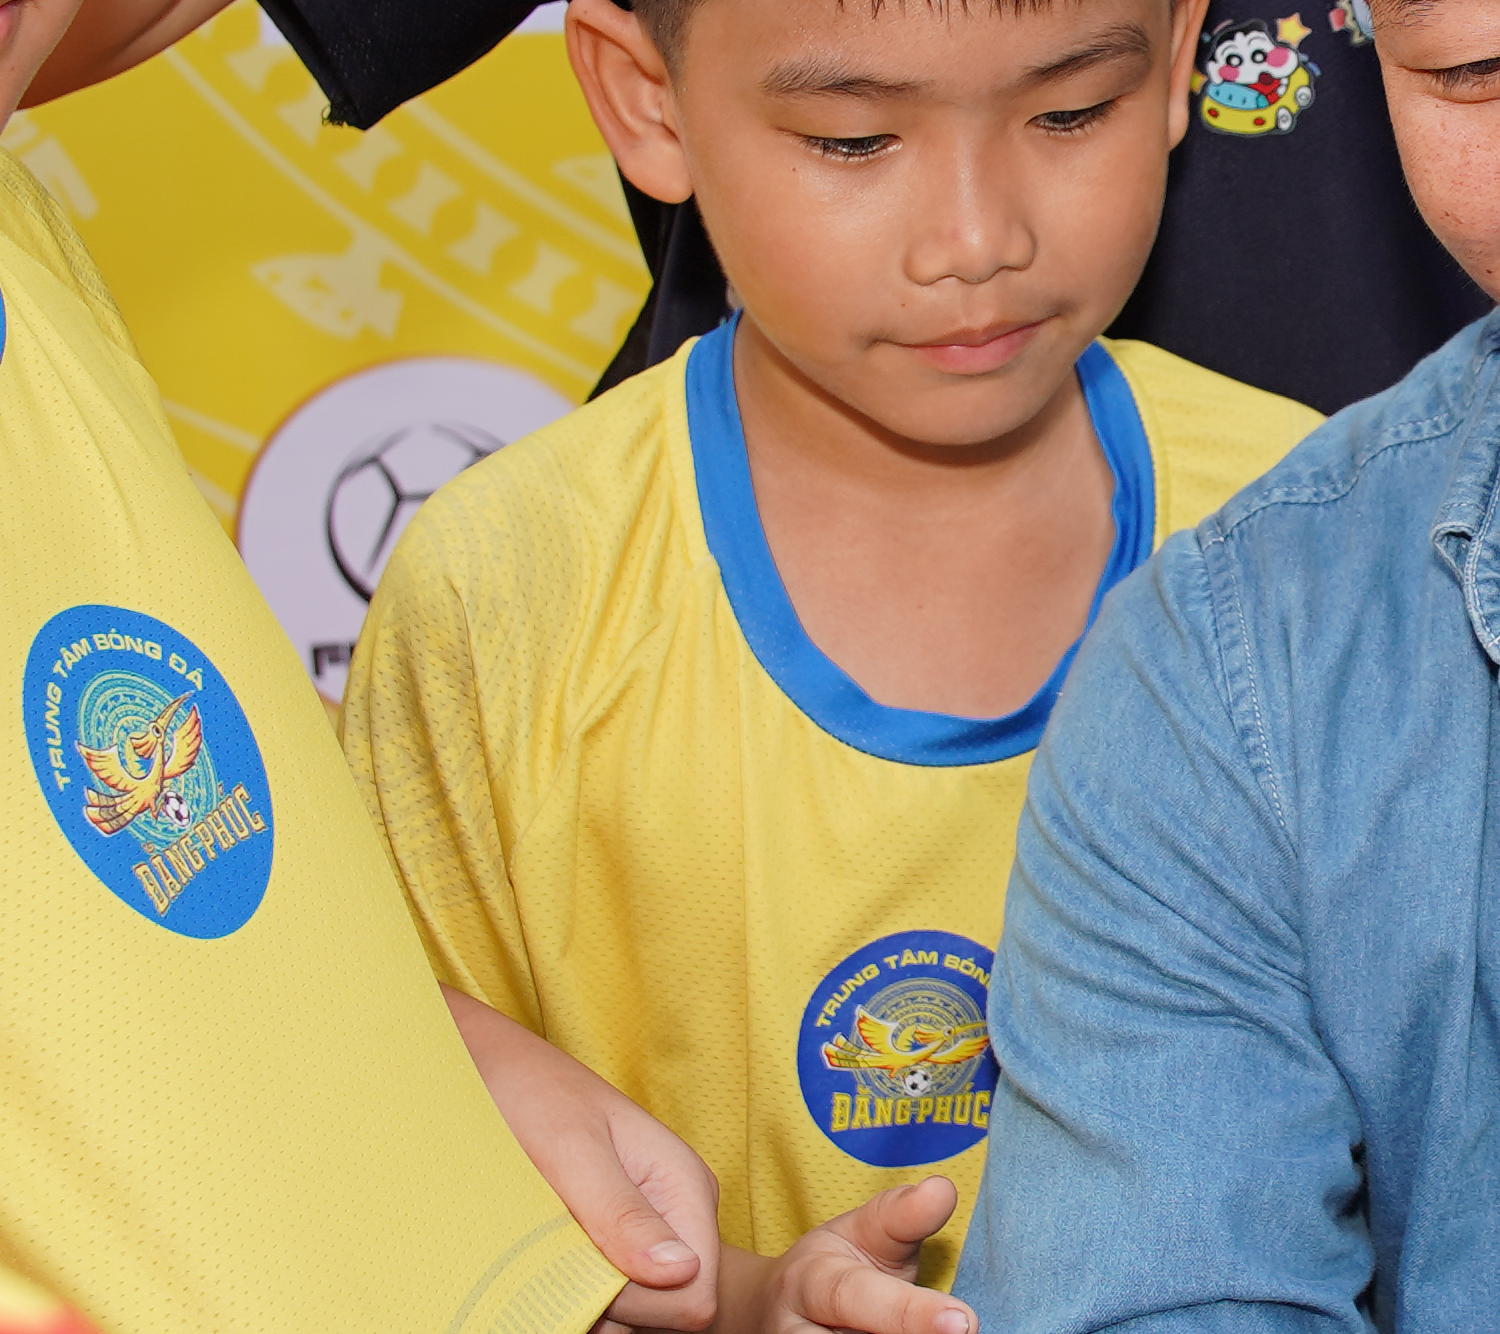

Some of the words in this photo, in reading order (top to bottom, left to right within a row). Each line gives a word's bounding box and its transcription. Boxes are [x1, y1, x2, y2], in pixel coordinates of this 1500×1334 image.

[52, 637, 95, 679] TÂM
[92, 627, 164, 661] BÓNG
[167, 652, 204, 692] ĐÁ
[45, 681, 72, 791] TRUNG
[192, 782, 269, 861] PHÚC
[815, 963, 881, 1028] TRUNG
[883, 948, 940, 970] TÂM
[914, 1081, 991, 1130] PHÚC
